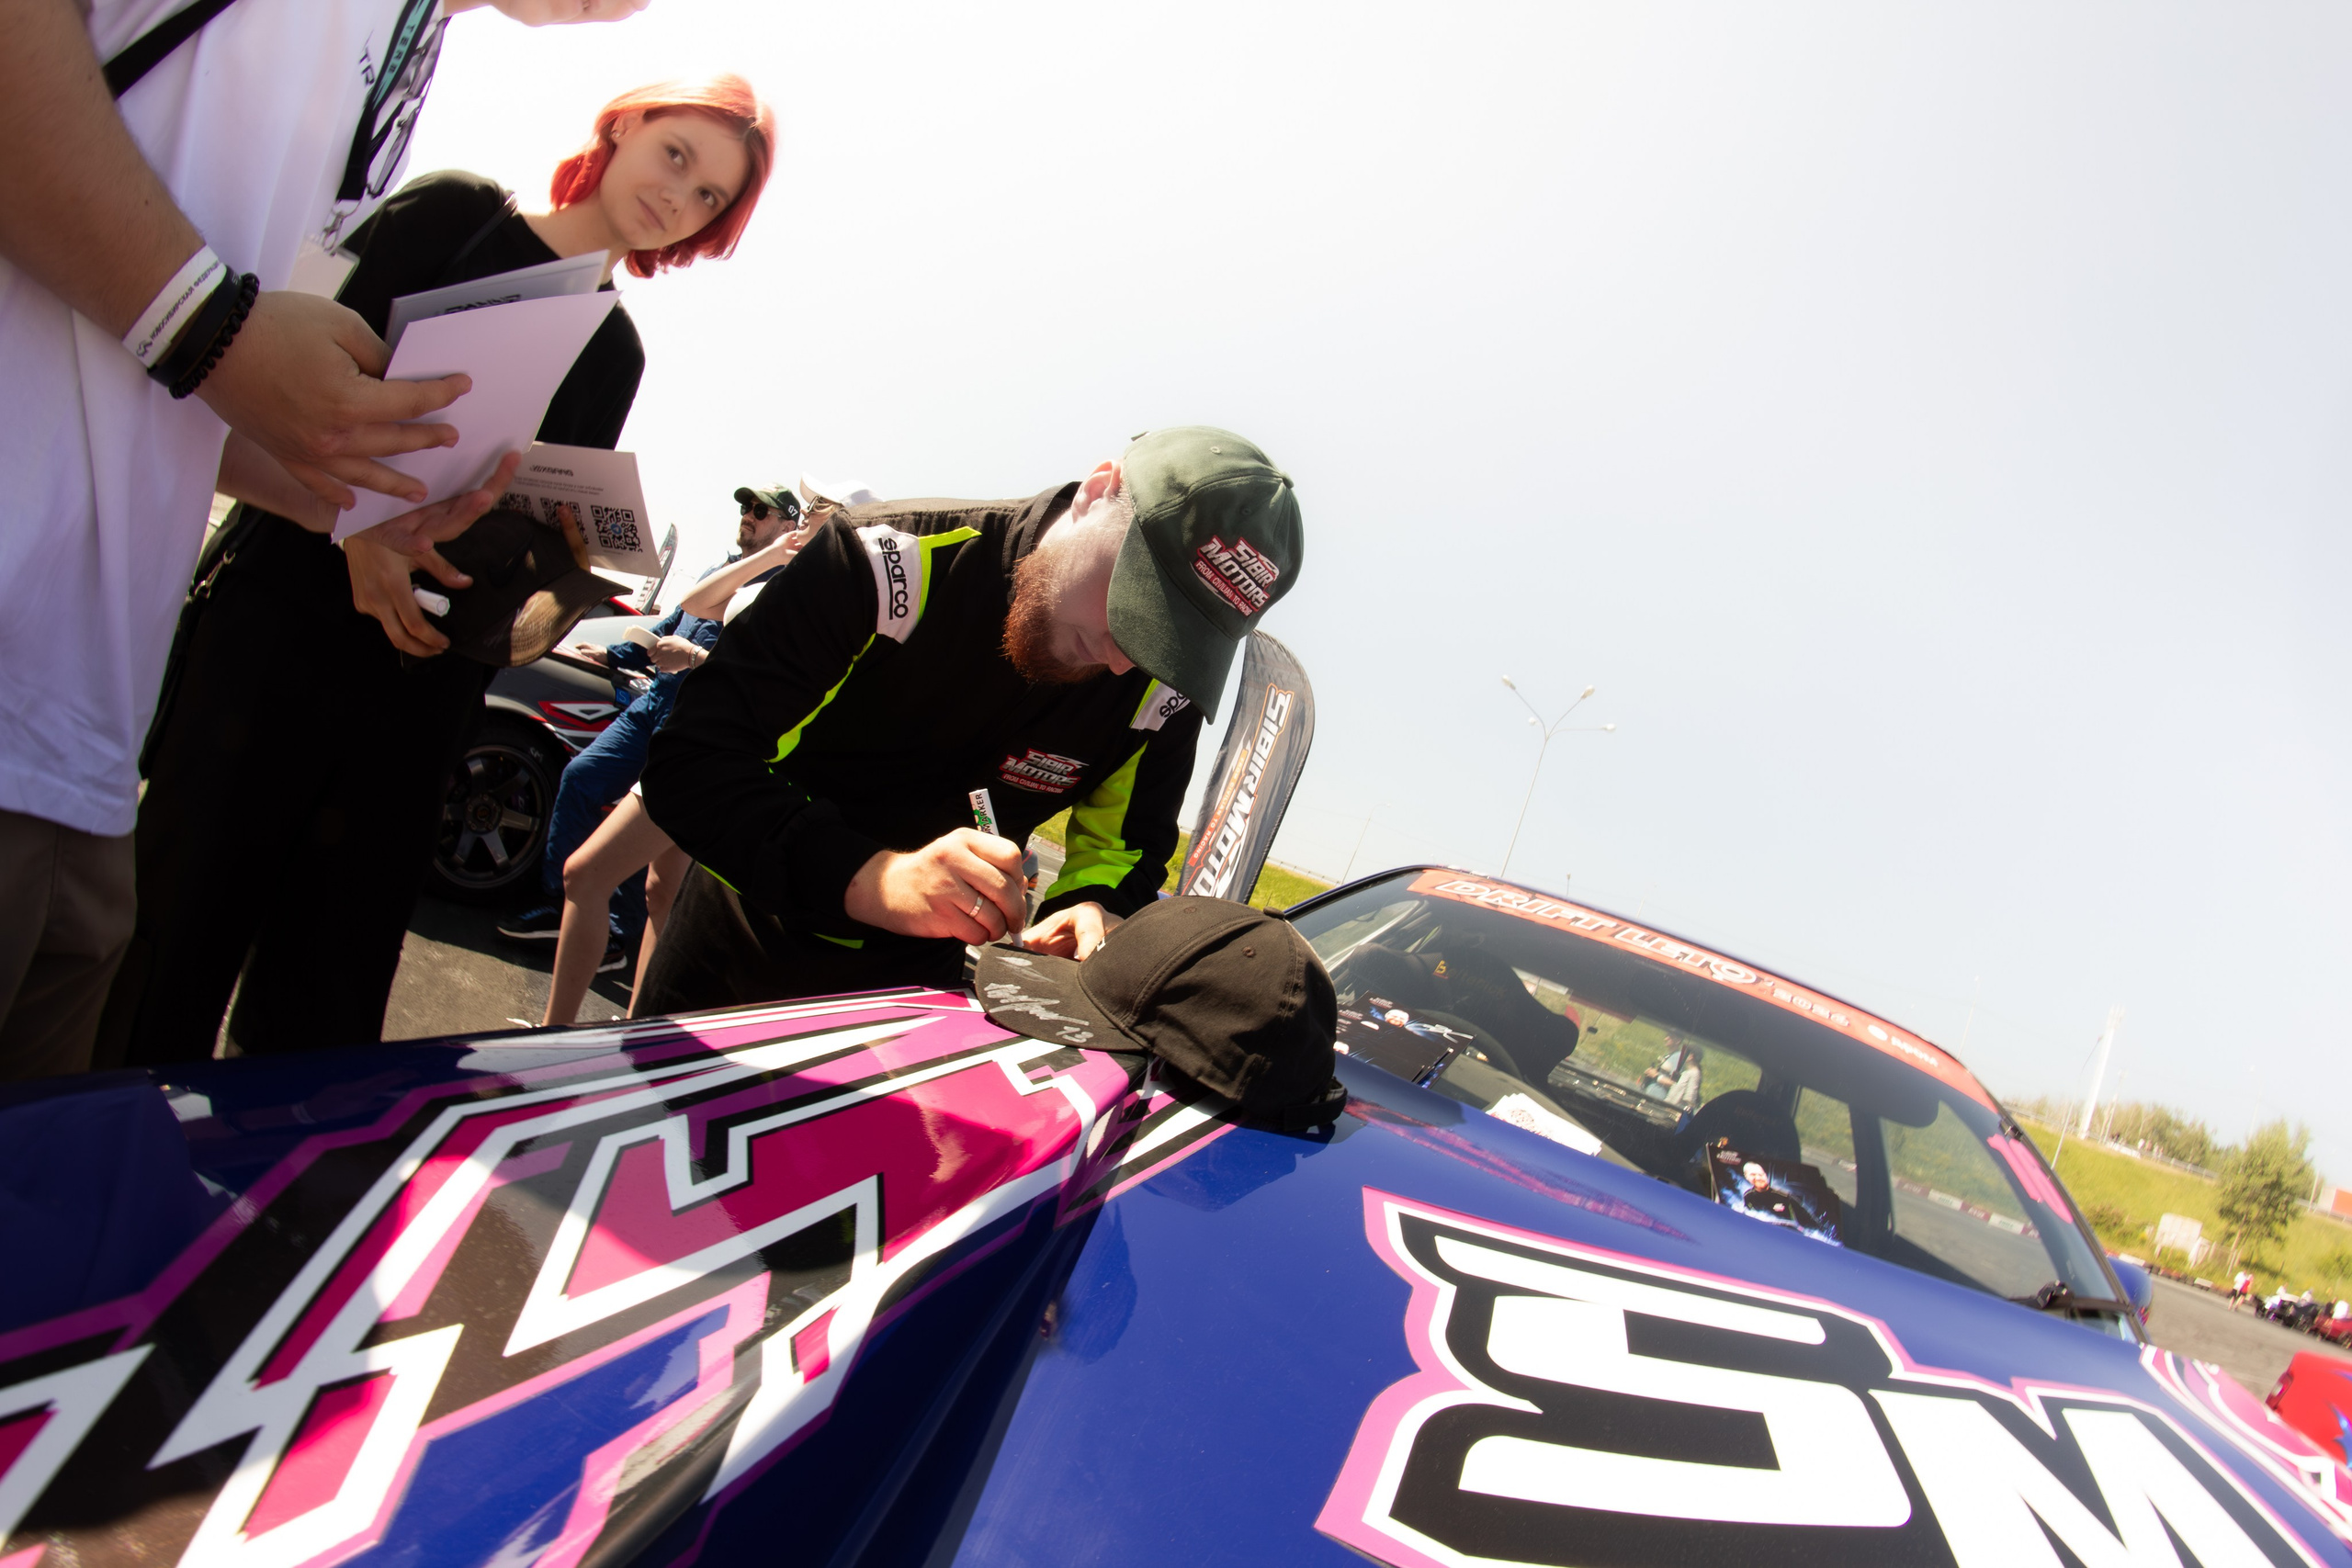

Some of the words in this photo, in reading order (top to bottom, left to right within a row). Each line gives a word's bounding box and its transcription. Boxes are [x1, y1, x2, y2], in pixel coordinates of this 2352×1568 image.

[787, 504, 798, 517] 07
[882, 537, 909, 618] sparco
[1200, 537, 1269, 607] MOTORS
[1228, 539, 1275, 587] SIBIR
[1195, 560, 1215, 581] FROM
[1212, 576, 1233, 599] CIVILIAN
[1232, 594, 1240, 605] TO
[1001, 757, 1078, 786] MOTORS
[1023, 750, 1075, 774] SIBIR
[1234, 757, 1244, 780] FROM
[1002, 774, 1019, 783] FROM
[1019, 778, 1040, 789] CIVILIAN
[975, 793, 991, 833] MARKER
[1217, 782, 1235, 816] CIVILIAN
[1210, 818, 1218, 829] TO
[1193, 831, 1212, 859] RACING
[1435, 880, 1617, 931] DRIFT
